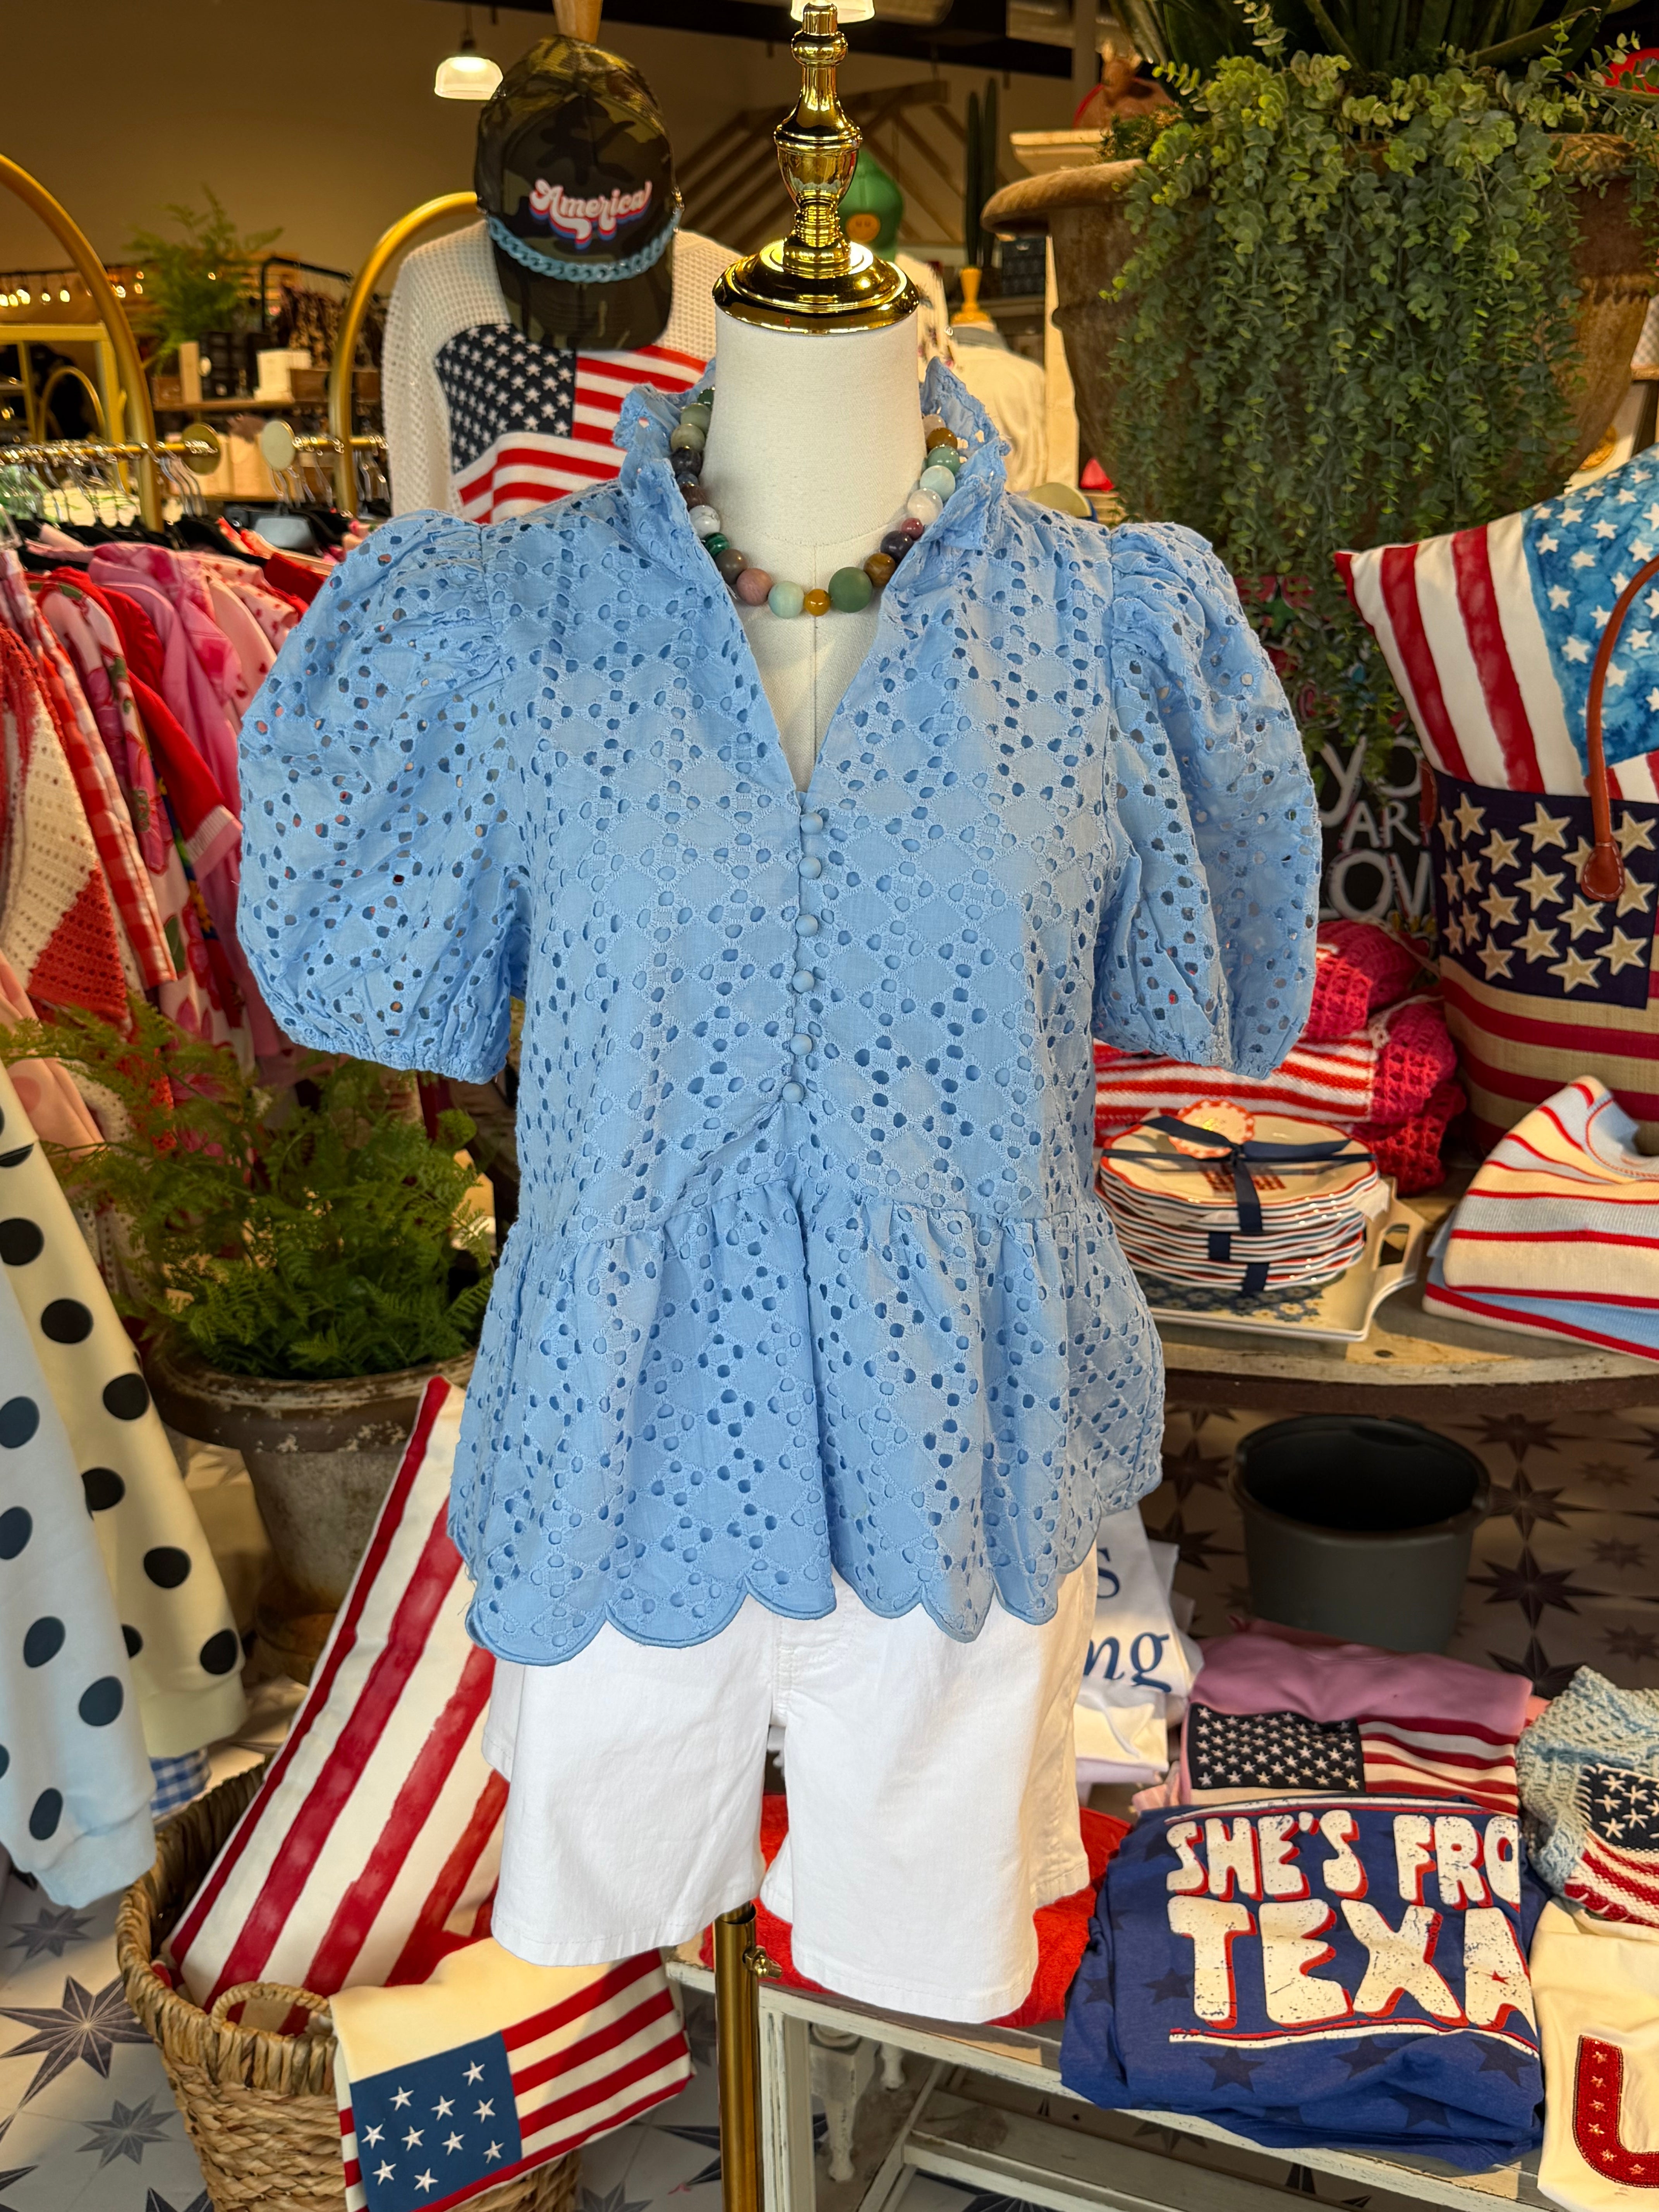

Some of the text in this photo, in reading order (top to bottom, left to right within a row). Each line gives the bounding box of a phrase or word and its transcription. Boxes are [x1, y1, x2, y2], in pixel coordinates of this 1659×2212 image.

[529, 179, 653, 250] America
[1338, 800, 1431, 852] AR
[1318, 850, 1435, 921] OV
[1166, 1810, 1368, 1901] SHE'S
[1167, 1895, 1537, 2030] TEXA
